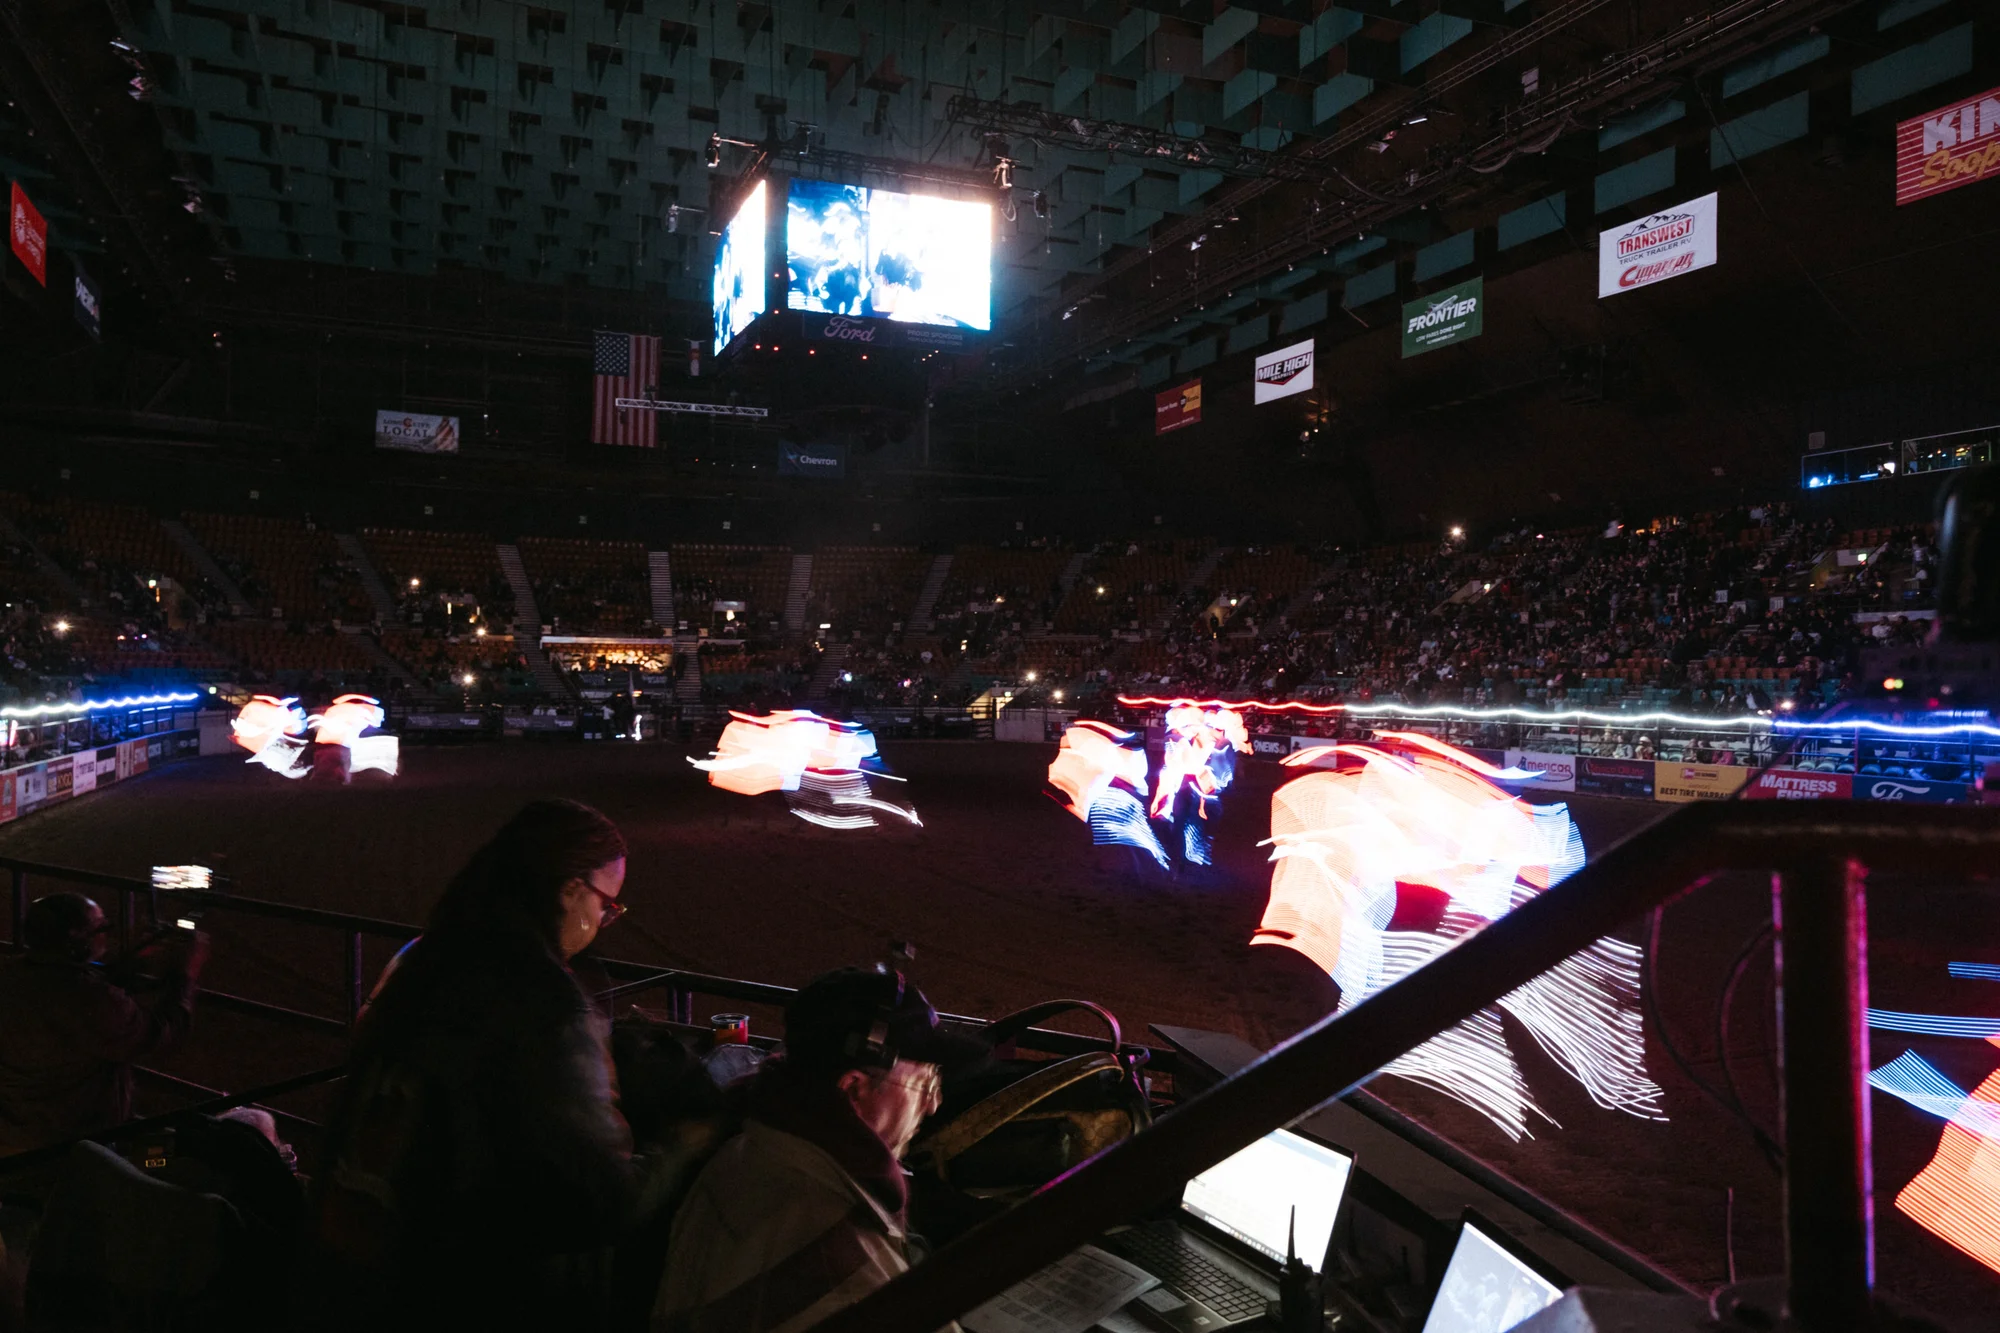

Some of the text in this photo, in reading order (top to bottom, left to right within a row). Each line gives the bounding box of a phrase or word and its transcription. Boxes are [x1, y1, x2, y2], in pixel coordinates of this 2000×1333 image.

[1619, 218, 1692, 255] TRANSWEST
[1620, 237, 1692, 265] TRUCK TRAILER RV
[1619, 252, 1694, 288] Cimarron
[824, 316, 876, 342] Ford
[1407, 298, 1477, 334] FRONTIER
[1257, 353, 1311, 381] MILE HIGH
[383, 425, 431, 437] LOCAL
[800, 455, 837, 465] Chevron
[1253, 739, 1281, 754] 9NEWS
[1660, 787, 1678, 795] BEST
[1680, 789, 1696, 797] TIRE
[1760, 774, 1837, 793] MATTRESS
